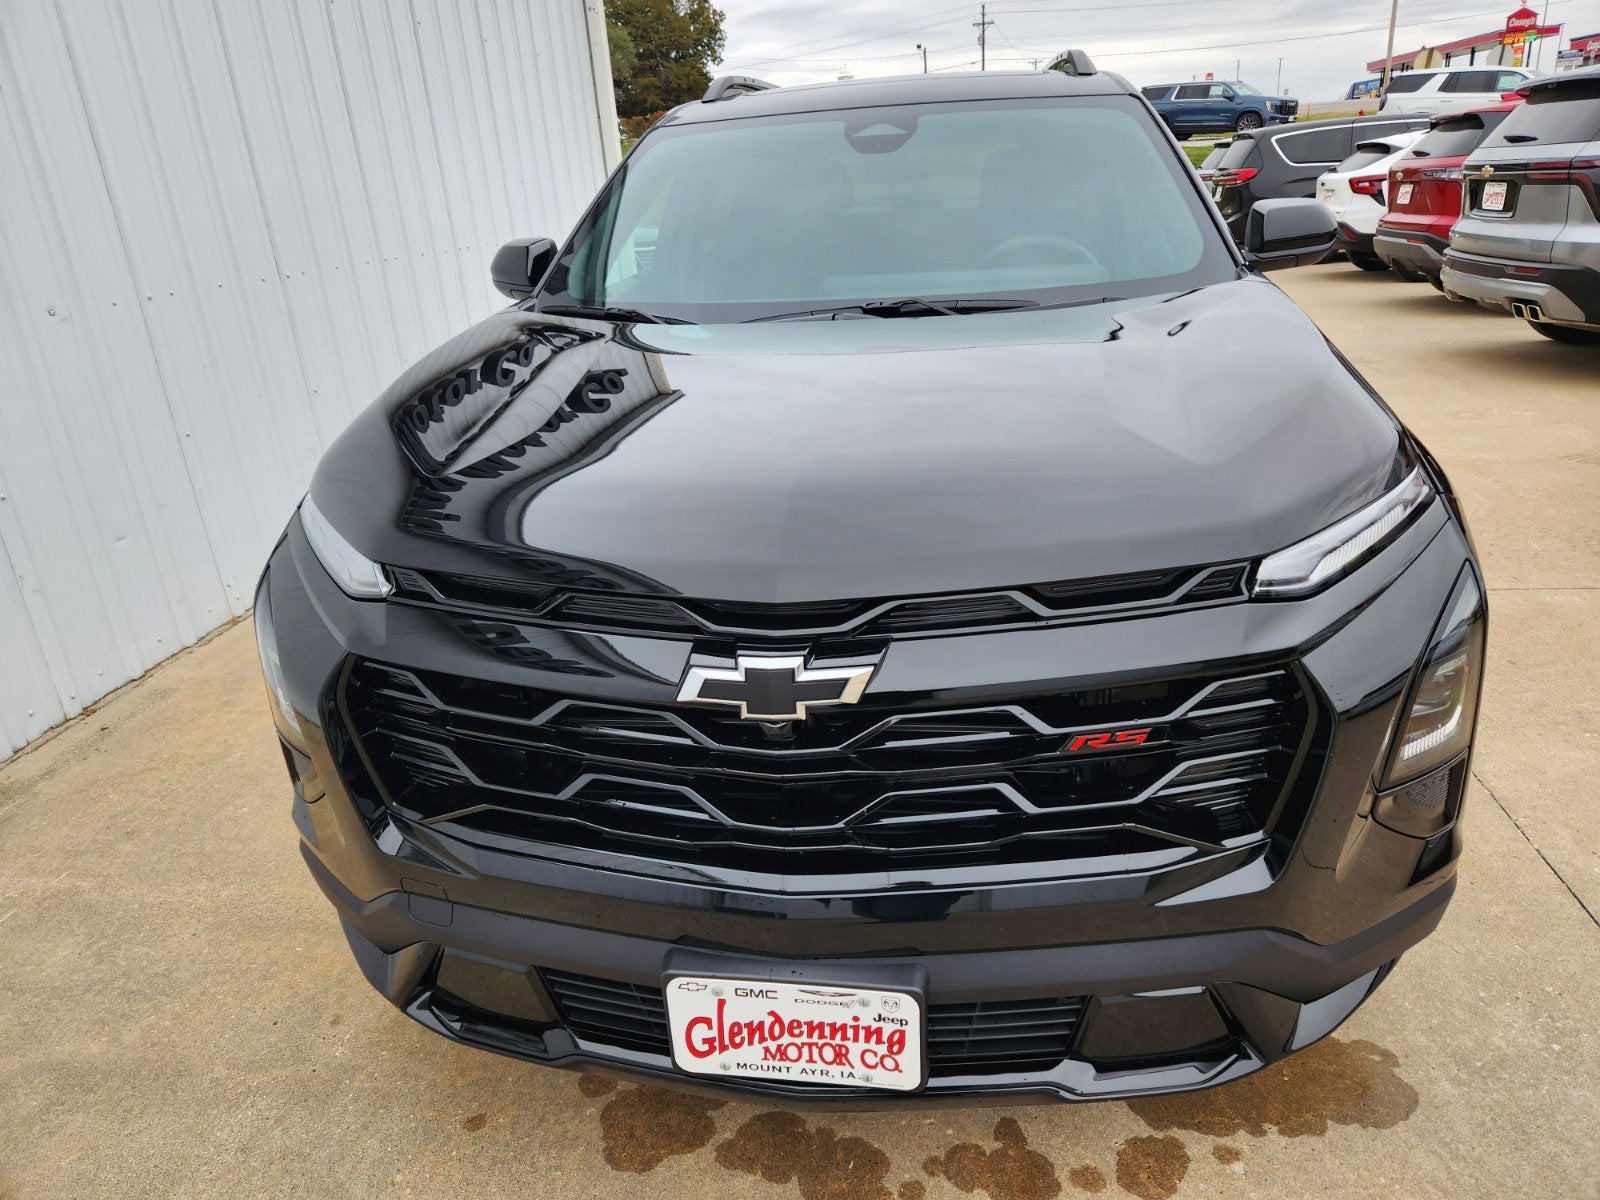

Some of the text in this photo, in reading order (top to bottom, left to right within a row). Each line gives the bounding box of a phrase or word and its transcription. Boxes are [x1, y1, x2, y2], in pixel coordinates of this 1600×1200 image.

[1069, 727, 1153, 751] RS
[734, 987, 778, 1000] GMC
[794, 998, 851, 1008] DODGE
[684, 998, 906, 1059] Glendenning
[873, 1013, 909, 1027] Jeep
[762, 1041, 855, 1069] MOTOR
[736, 1062, 863, 1081] MOUNT AYR, IA.
